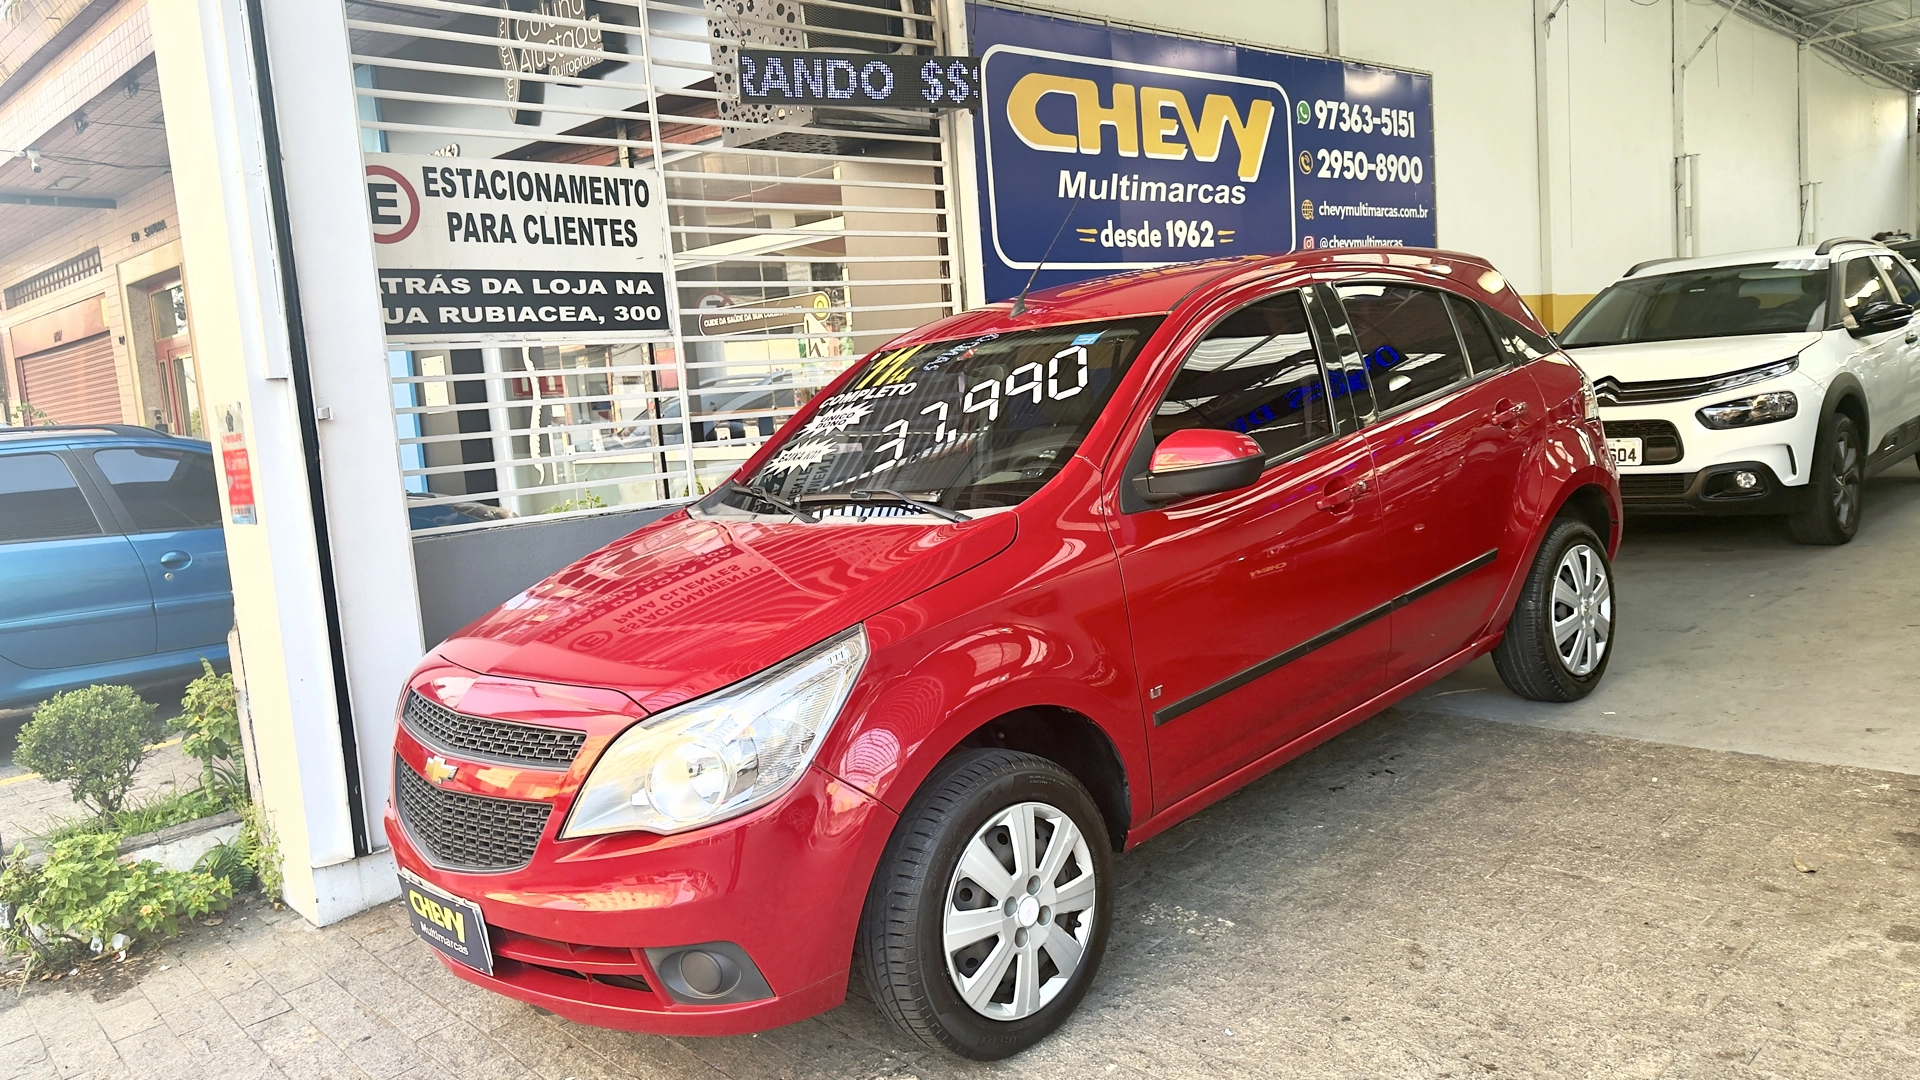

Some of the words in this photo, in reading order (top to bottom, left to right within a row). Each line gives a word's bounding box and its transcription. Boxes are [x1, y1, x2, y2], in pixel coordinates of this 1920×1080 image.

[1006, 72, 1275, 183] CHEVY
[1314, 99, 1415, 139] 97363-5151
[1317, 148, 1423, 184] 2950-8900
[367, 182, 402, 225] E
[422, 166, 650, 208] ESTACIONAMENTO
[1058, 169, 1246, 205] Multimarcas
[1318, 201, 1429, 220] chevymultimarcas.com.br
[446, 211, 517, 244] PARA
[523, 214, 639, 248] CLIENTES
[1100, 219, 1162, 248] desde
[1165, 219, 1215, 248] 1962
[380, 274, 471, 295] TRÁS
[481, 278, 524, 295] DA
[532, 278, 609, 295] LOJA
[615, 279, 655, 295] NA
[438, 305, 606, 325] RUBIACEA,
[613, 306, 662, 322] 300
[818, 382, 919, 410] COMPLETO
[409, 889, 466, 943] CHEVY
[420, 921, 469, 956] Multimarcas
